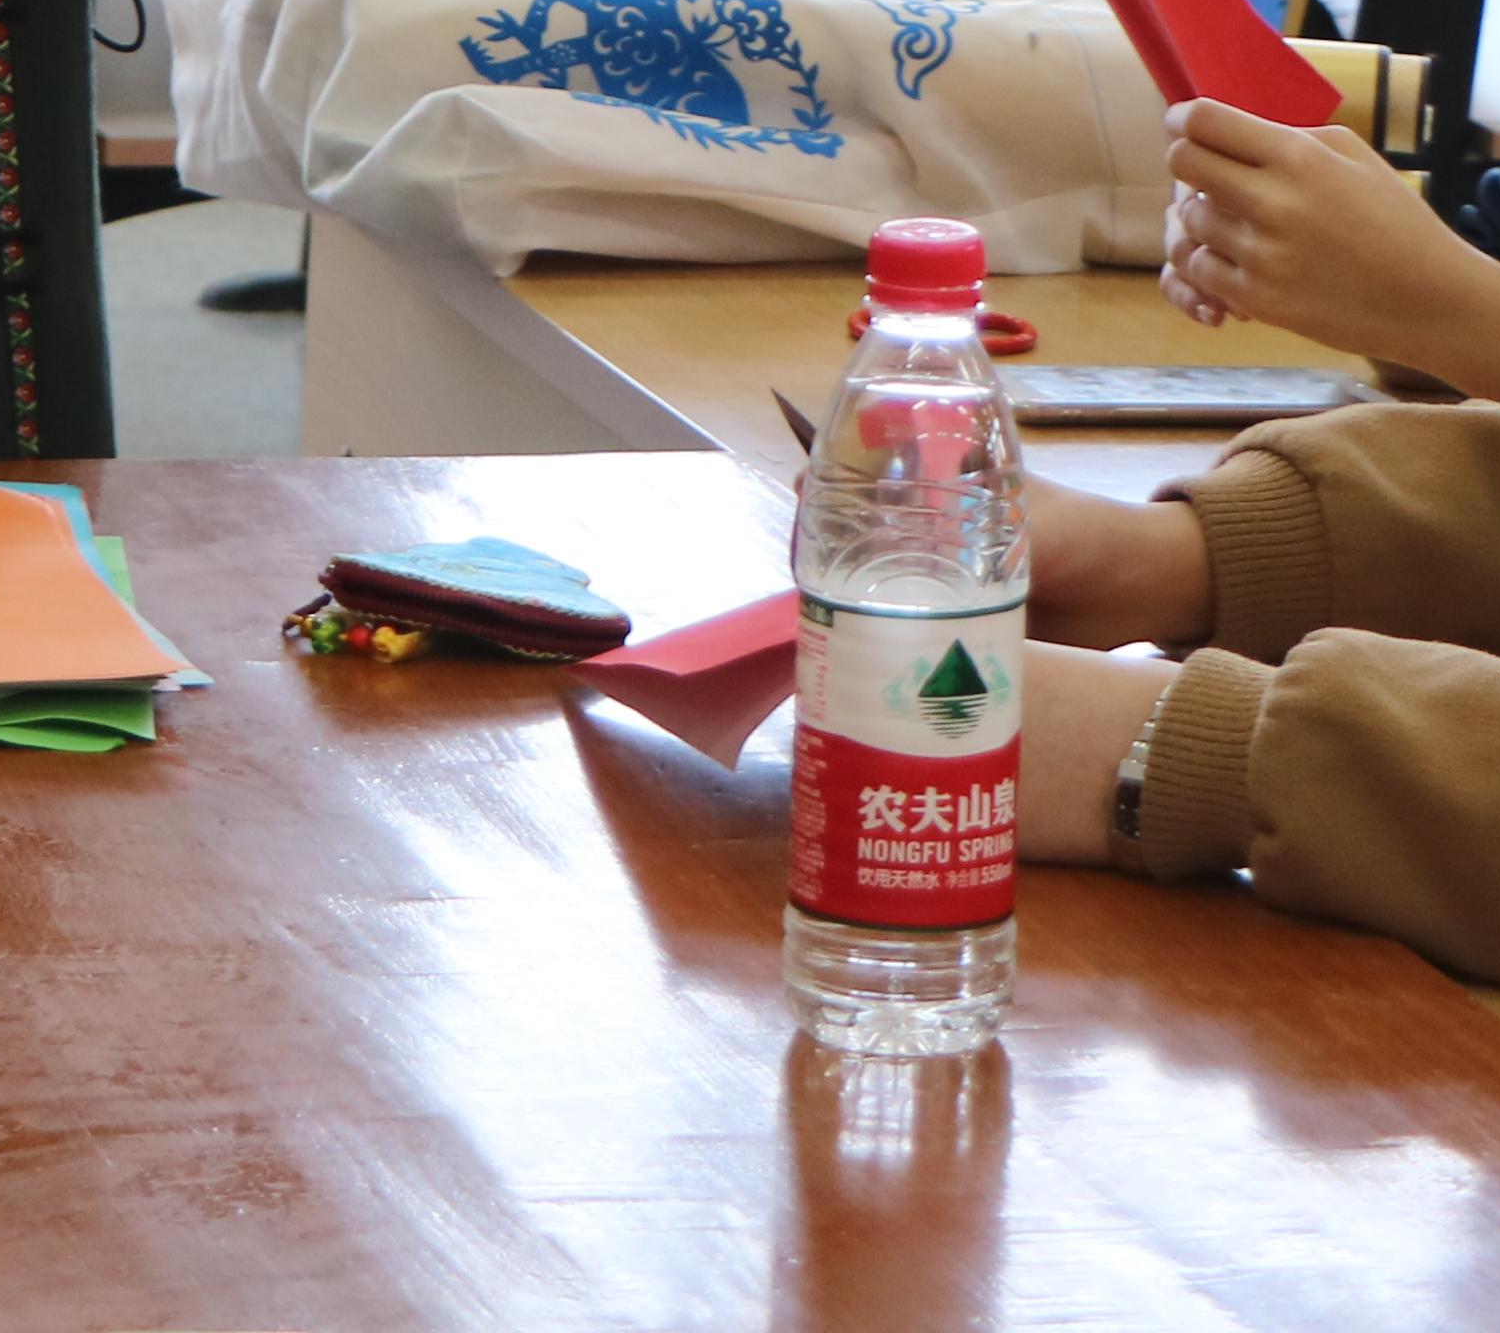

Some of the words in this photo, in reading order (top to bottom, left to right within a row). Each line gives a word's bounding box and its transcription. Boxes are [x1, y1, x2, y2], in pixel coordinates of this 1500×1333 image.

[858, 777, 1016, 833] 农夫山泉
[857, 837, 951, 864] NONGFU
[958, 829, 1014, 862] SPRING
[857, 867, 940, 890] 饮用天然水
